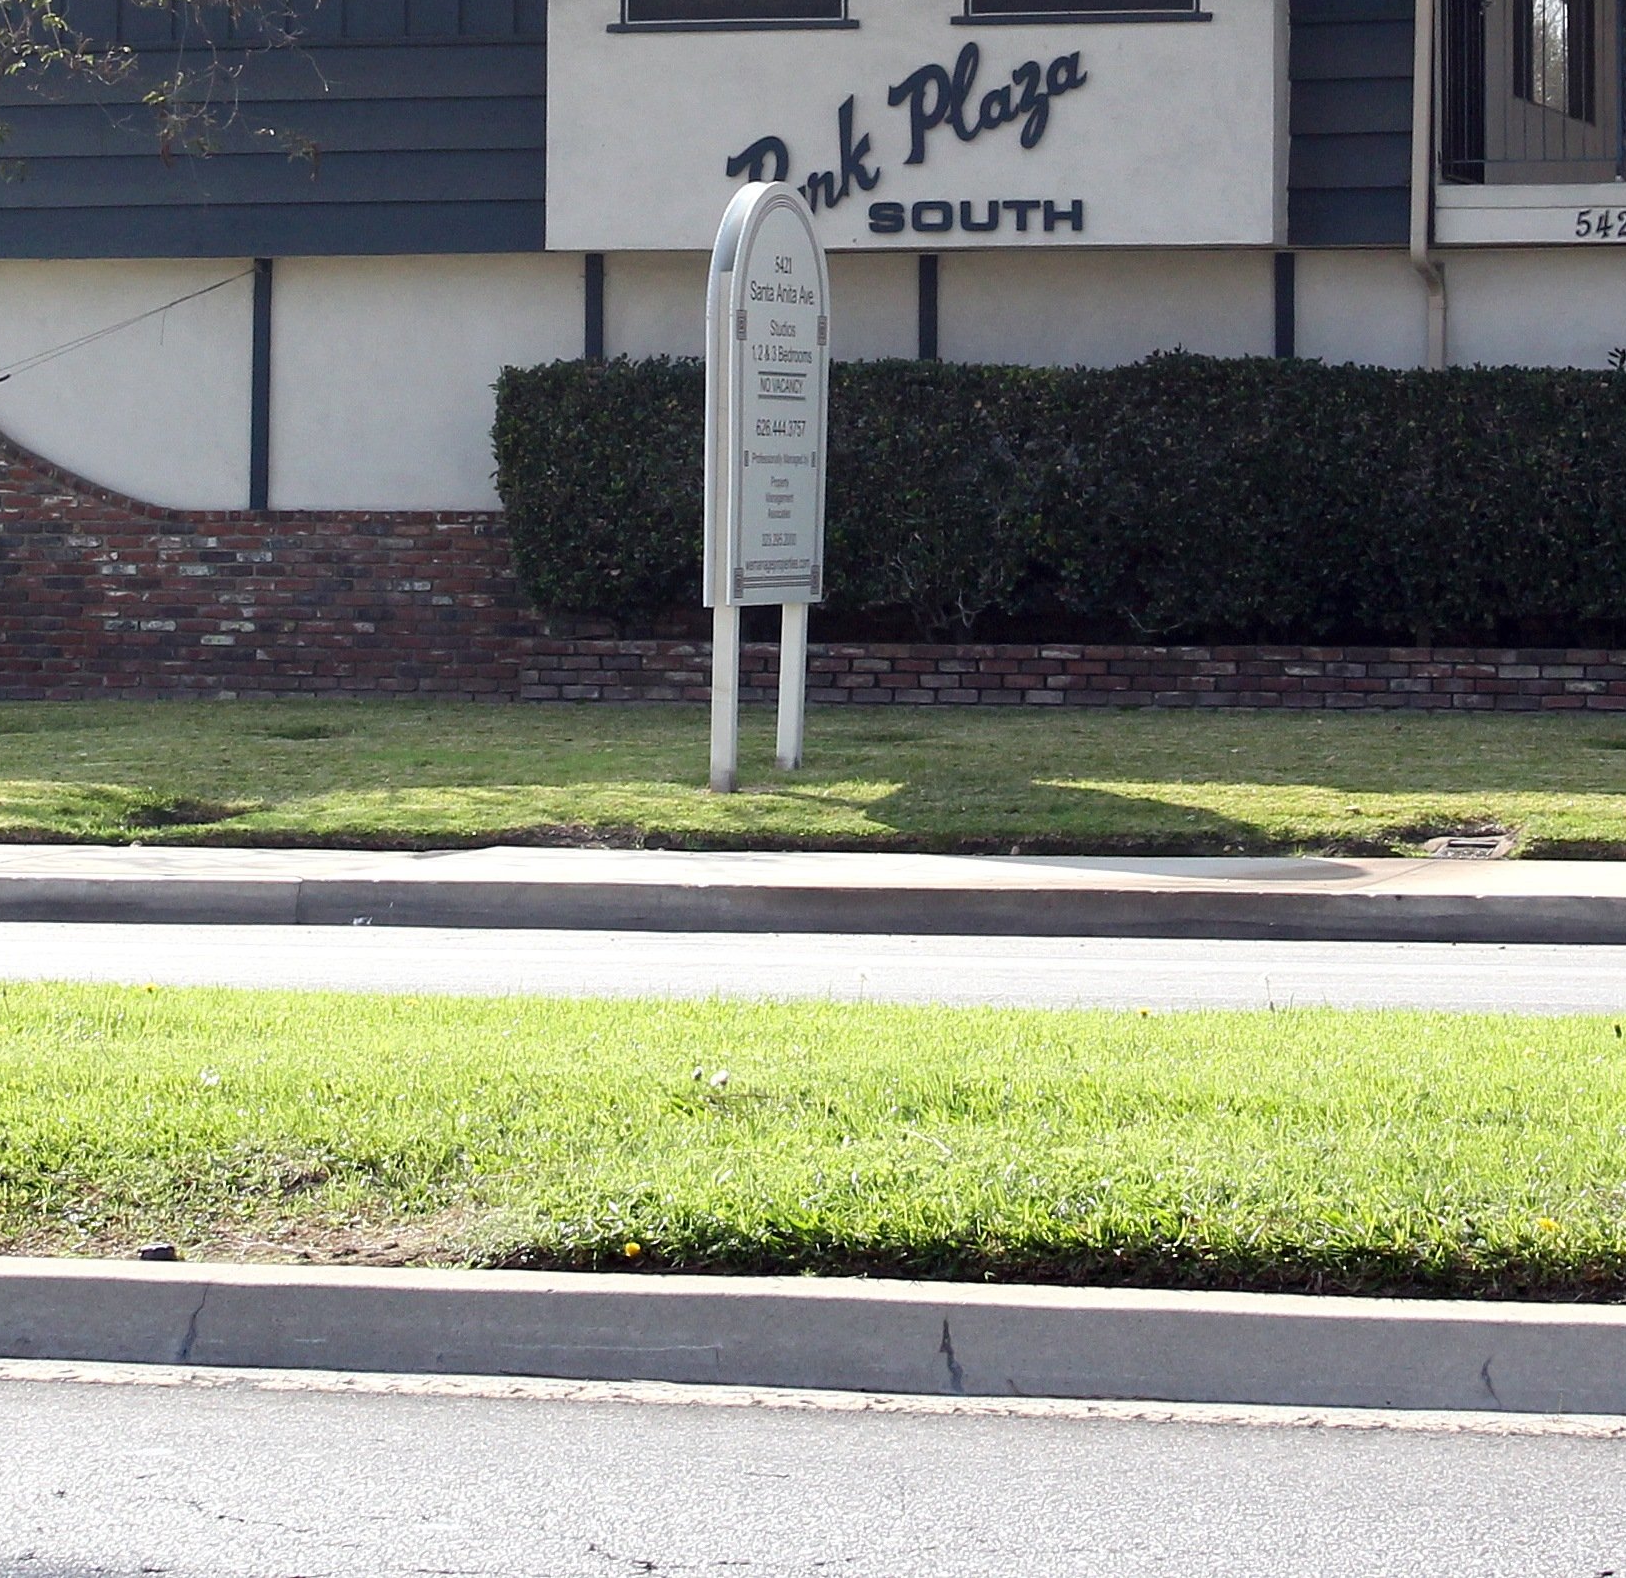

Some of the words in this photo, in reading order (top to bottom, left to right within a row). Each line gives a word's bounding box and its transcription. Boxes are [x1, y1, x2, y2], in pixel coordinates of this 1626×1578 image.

[726, 94, 880, 215] Prk
[887, 41, 1088, 164] Plaza
[868, 199, 1083, 233] SOUTH
[774, 255, 792, 274] 5421
[750, 280, 774, 302] Santa
[776, 282, 798, 304] Anita
[770, 318, 796, 338] Studios
[772, 345, 777, 362] 3
[778, 344, 813, 364] Bedrooms
[760, 377, 771, 393] NO
[772, 377, 804, 394] VACANCY
